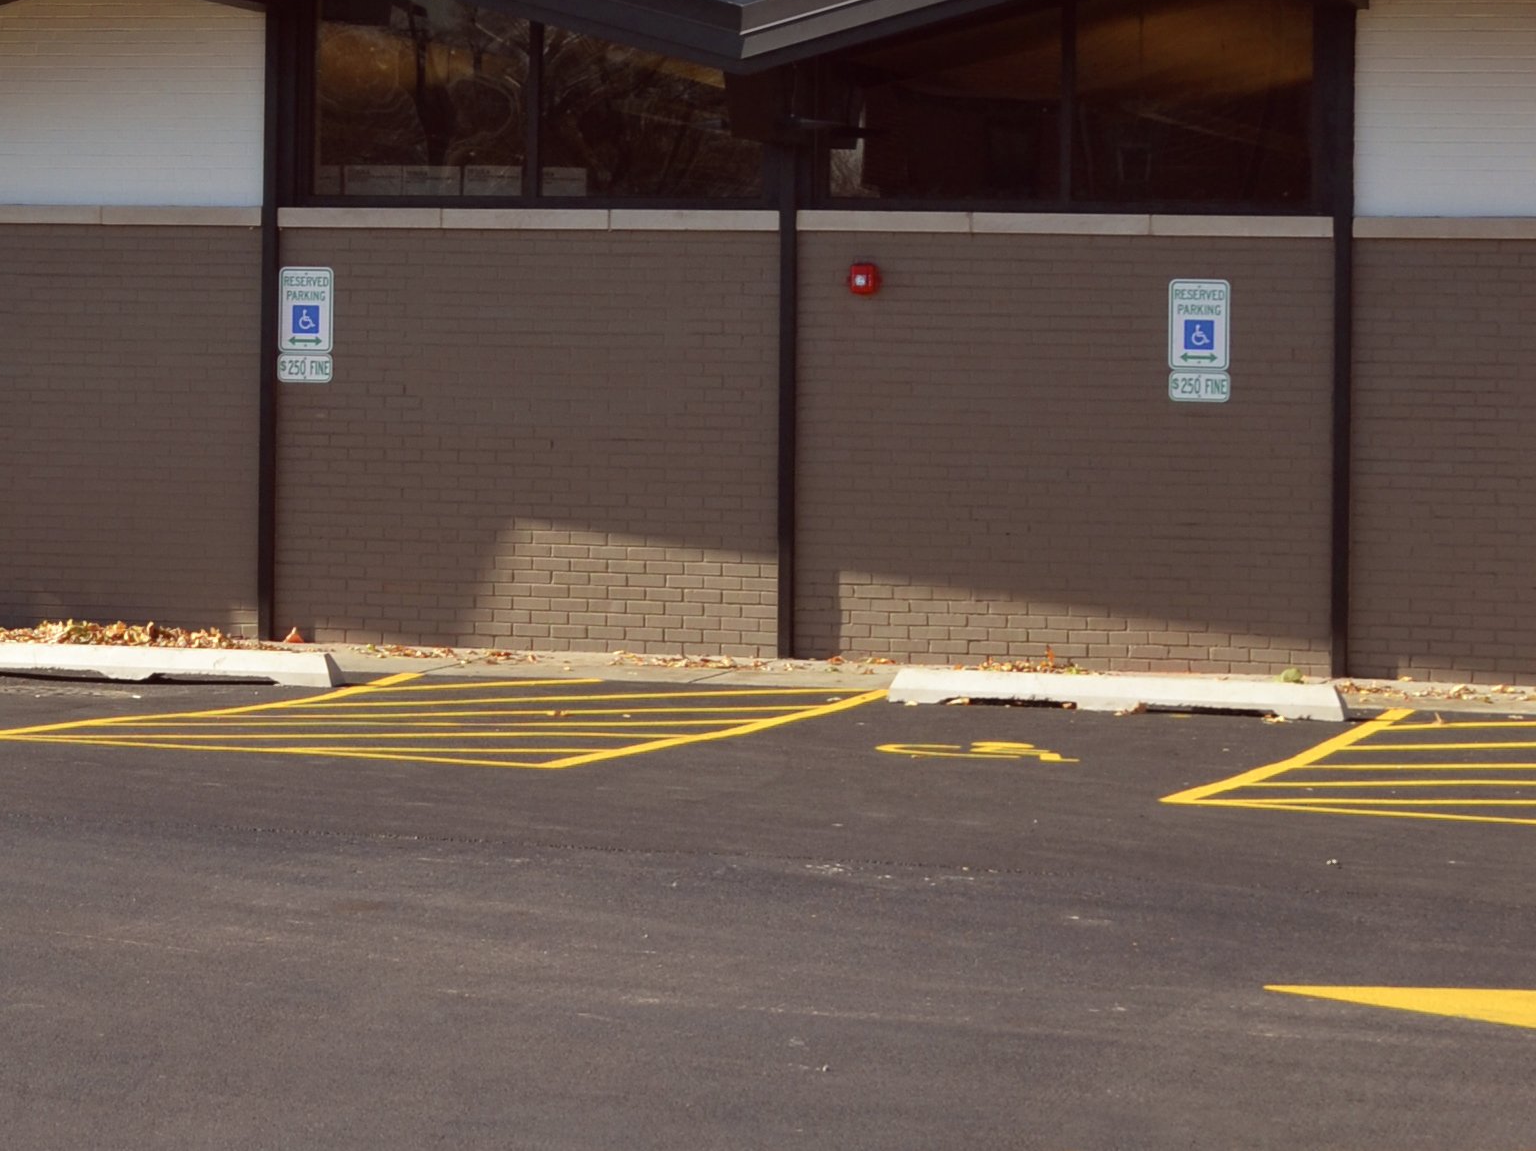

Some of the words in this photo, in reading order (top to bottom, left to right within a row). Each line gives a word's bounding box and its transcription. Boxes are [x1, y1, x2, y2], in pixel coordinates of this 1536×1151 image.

[284, 276, 329, 287] RESERVED
[286, 290, 326, 301] PARKING
[1174, 289, 1225, 301] RESERVED
[1177, 304, 1222, 316] PARKING
[310, 360, 330, 376] FINE
[1204, 378, 1228, 396] FINE
